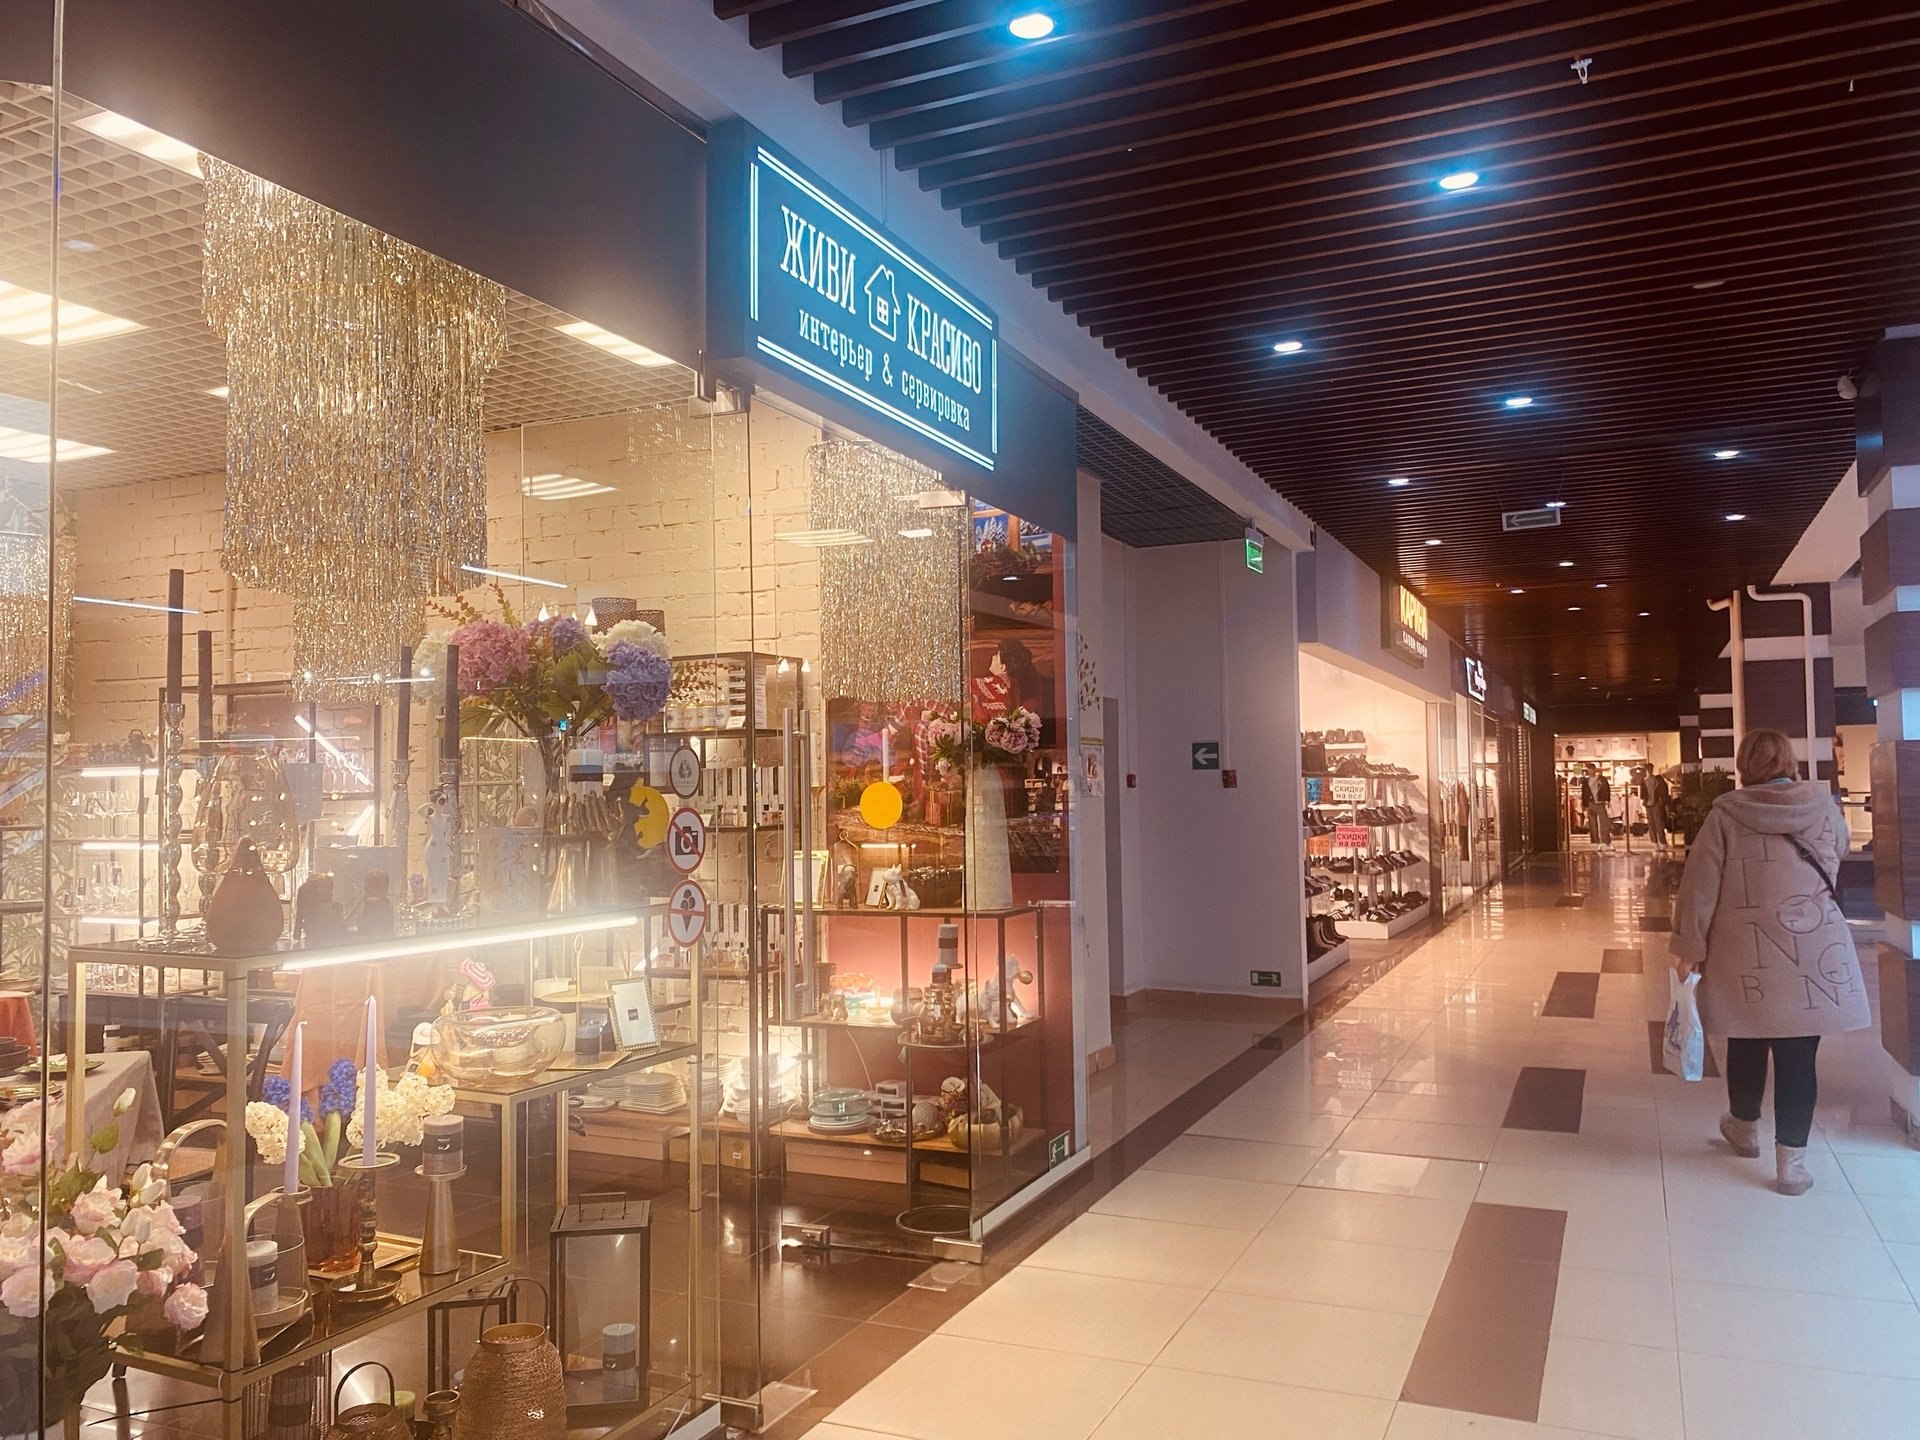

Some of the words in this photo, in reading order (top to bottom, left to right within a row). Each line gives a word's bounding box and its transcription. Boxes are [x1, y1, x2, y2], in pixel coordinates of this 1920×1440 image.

[780, 204, 856, 315] ЖИВИ
[906, 292, 983, 395] КРАСИВО
[799, 309, 873, 382] интерьер
[881, 353, 894, 388] &
[901, 369, 970, 432] сервировка
[1334, 785, 1364, 793] СКИДКИ
